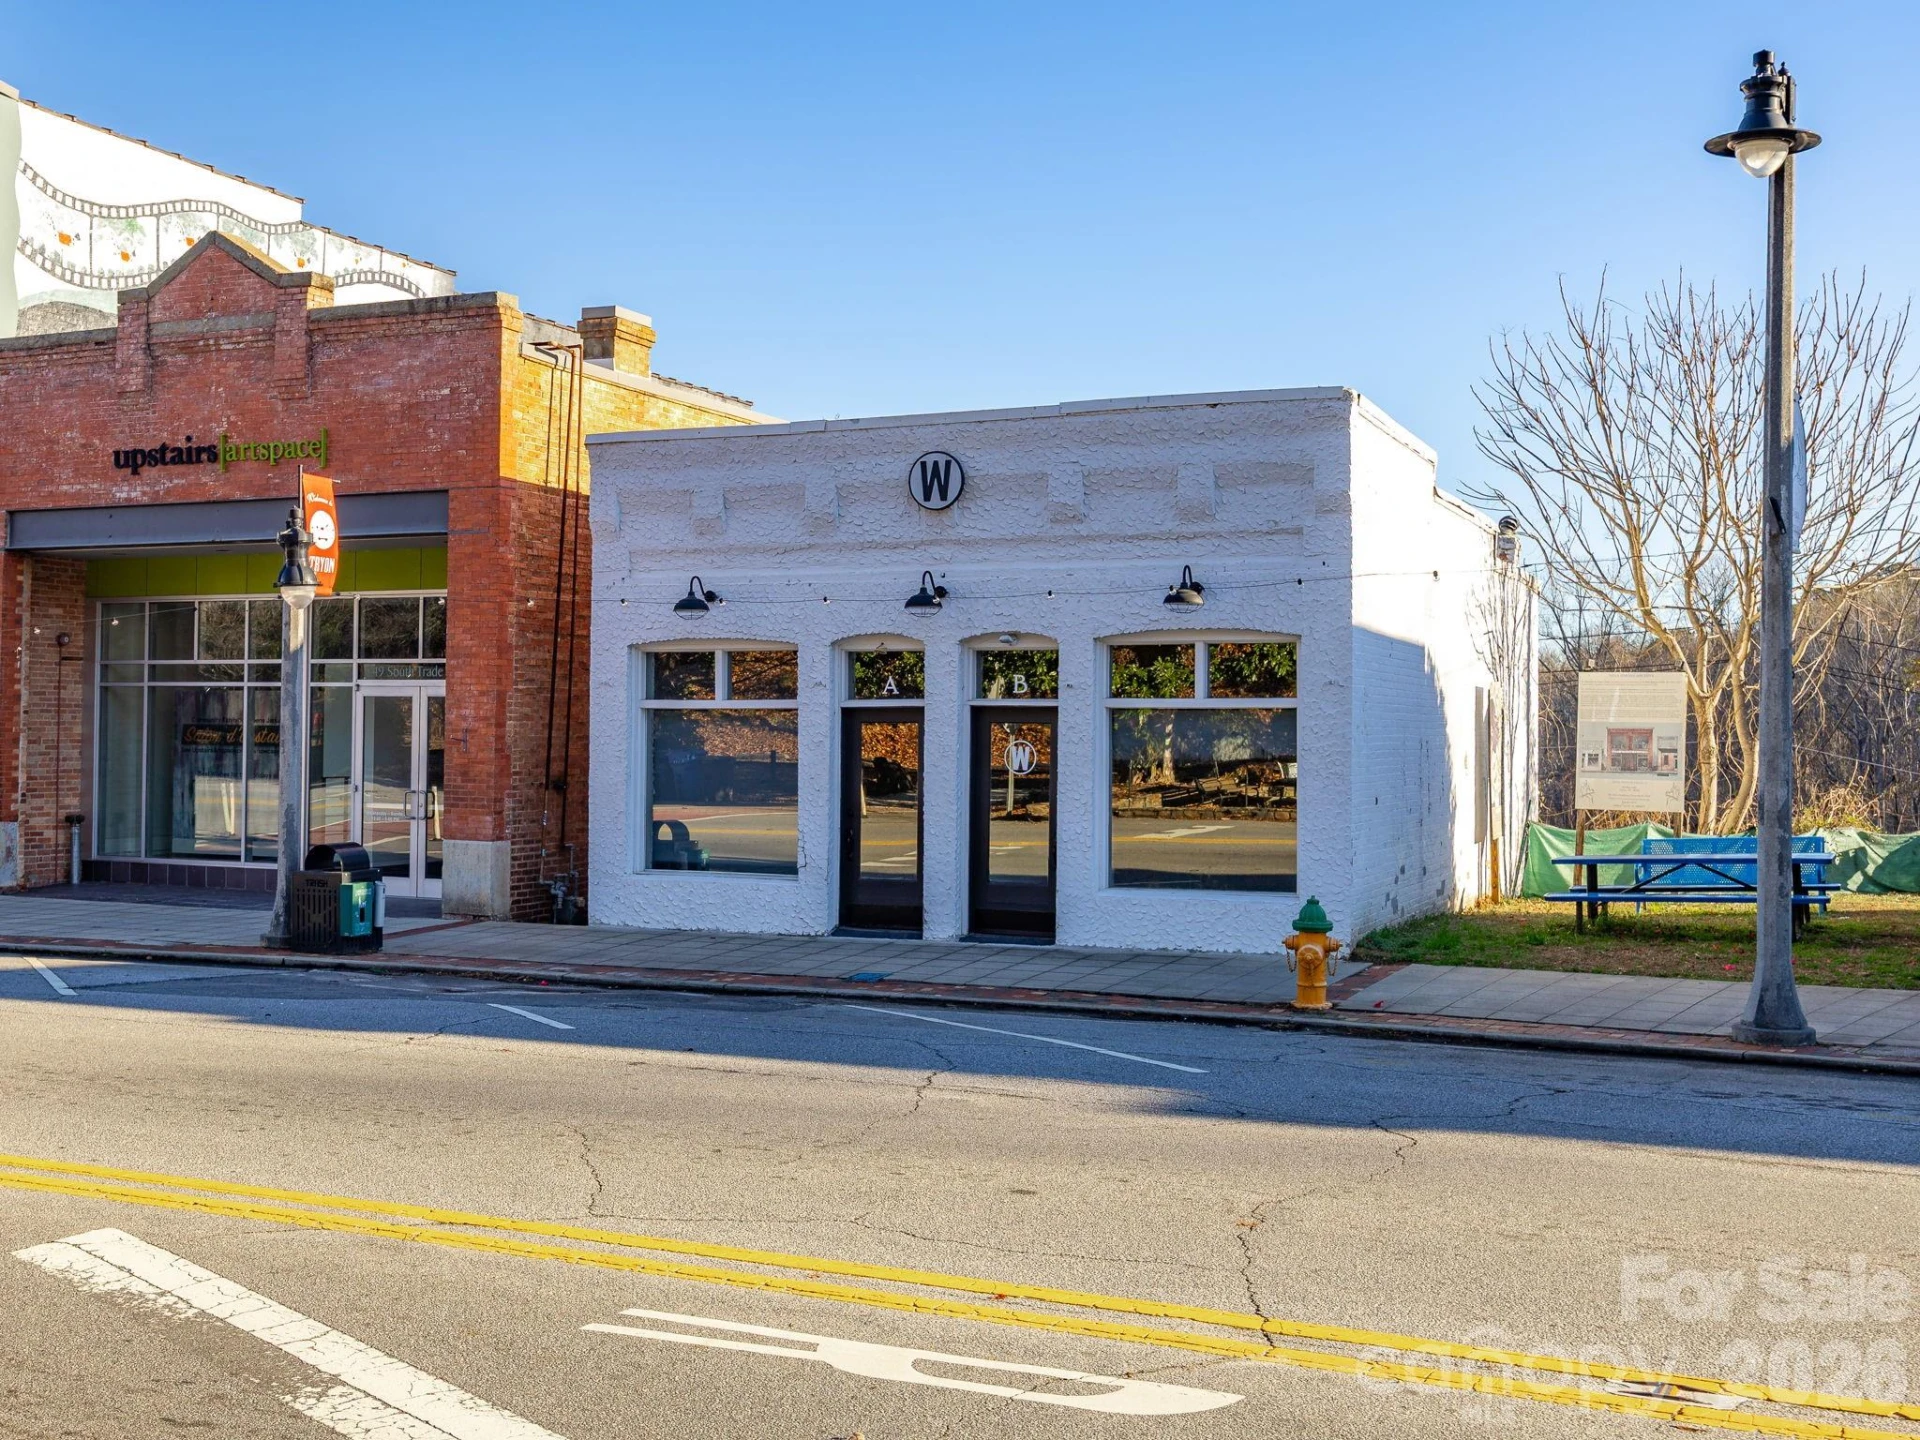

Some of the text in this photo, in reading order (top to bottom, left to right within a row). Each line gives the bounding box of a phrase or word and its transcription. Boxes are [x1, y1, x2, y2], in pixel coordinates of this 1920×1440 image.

[112, 434, 218, 476] upstairs
[920, 460, 953, 502] W
[308, 556, 336, 574] TRYON
[387, 665, 414, 678] South
[418, 665, 444, 678] Trade
[881, 675, 900, 695] A
[1012, 674, 1029, 694] B
[1010, 745, 1031, 771] W
[305, 879, 329, 888] TRASH
